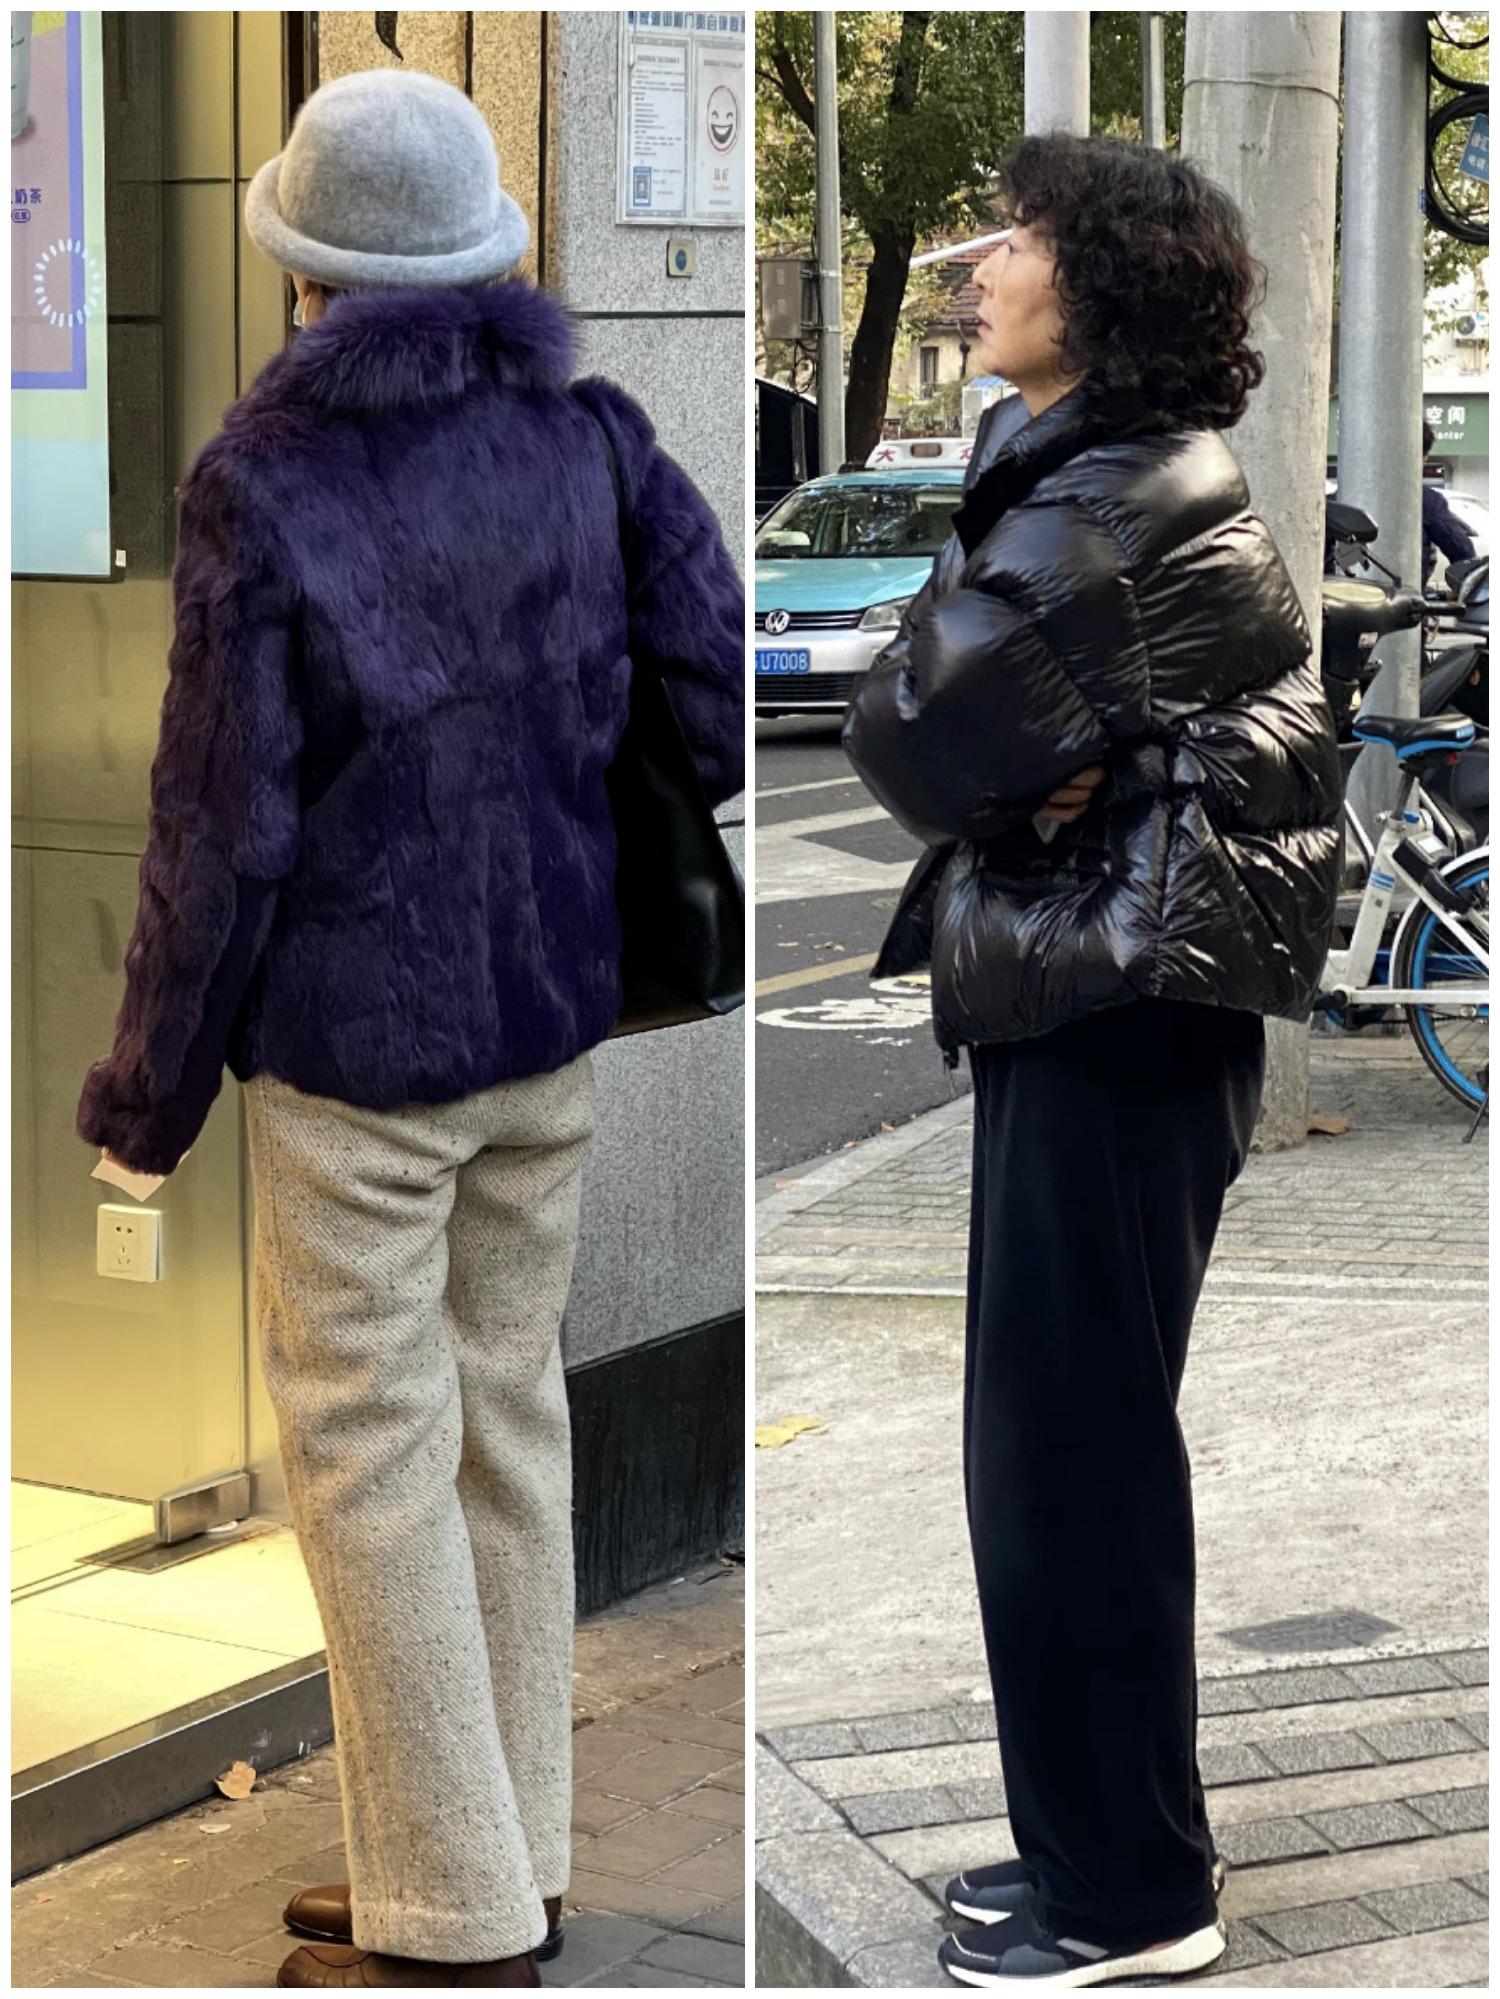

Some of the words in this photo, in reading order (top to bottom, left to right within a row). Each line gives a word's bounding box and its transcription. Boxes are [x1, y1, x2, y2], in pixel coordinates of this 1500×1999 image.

[11, 188, 42, 205] 奶茶
[1426, 405, 1465, 425] 空间
[1432, 431, 1464, 440] enter
[755, 652, 808, 671] U7008
